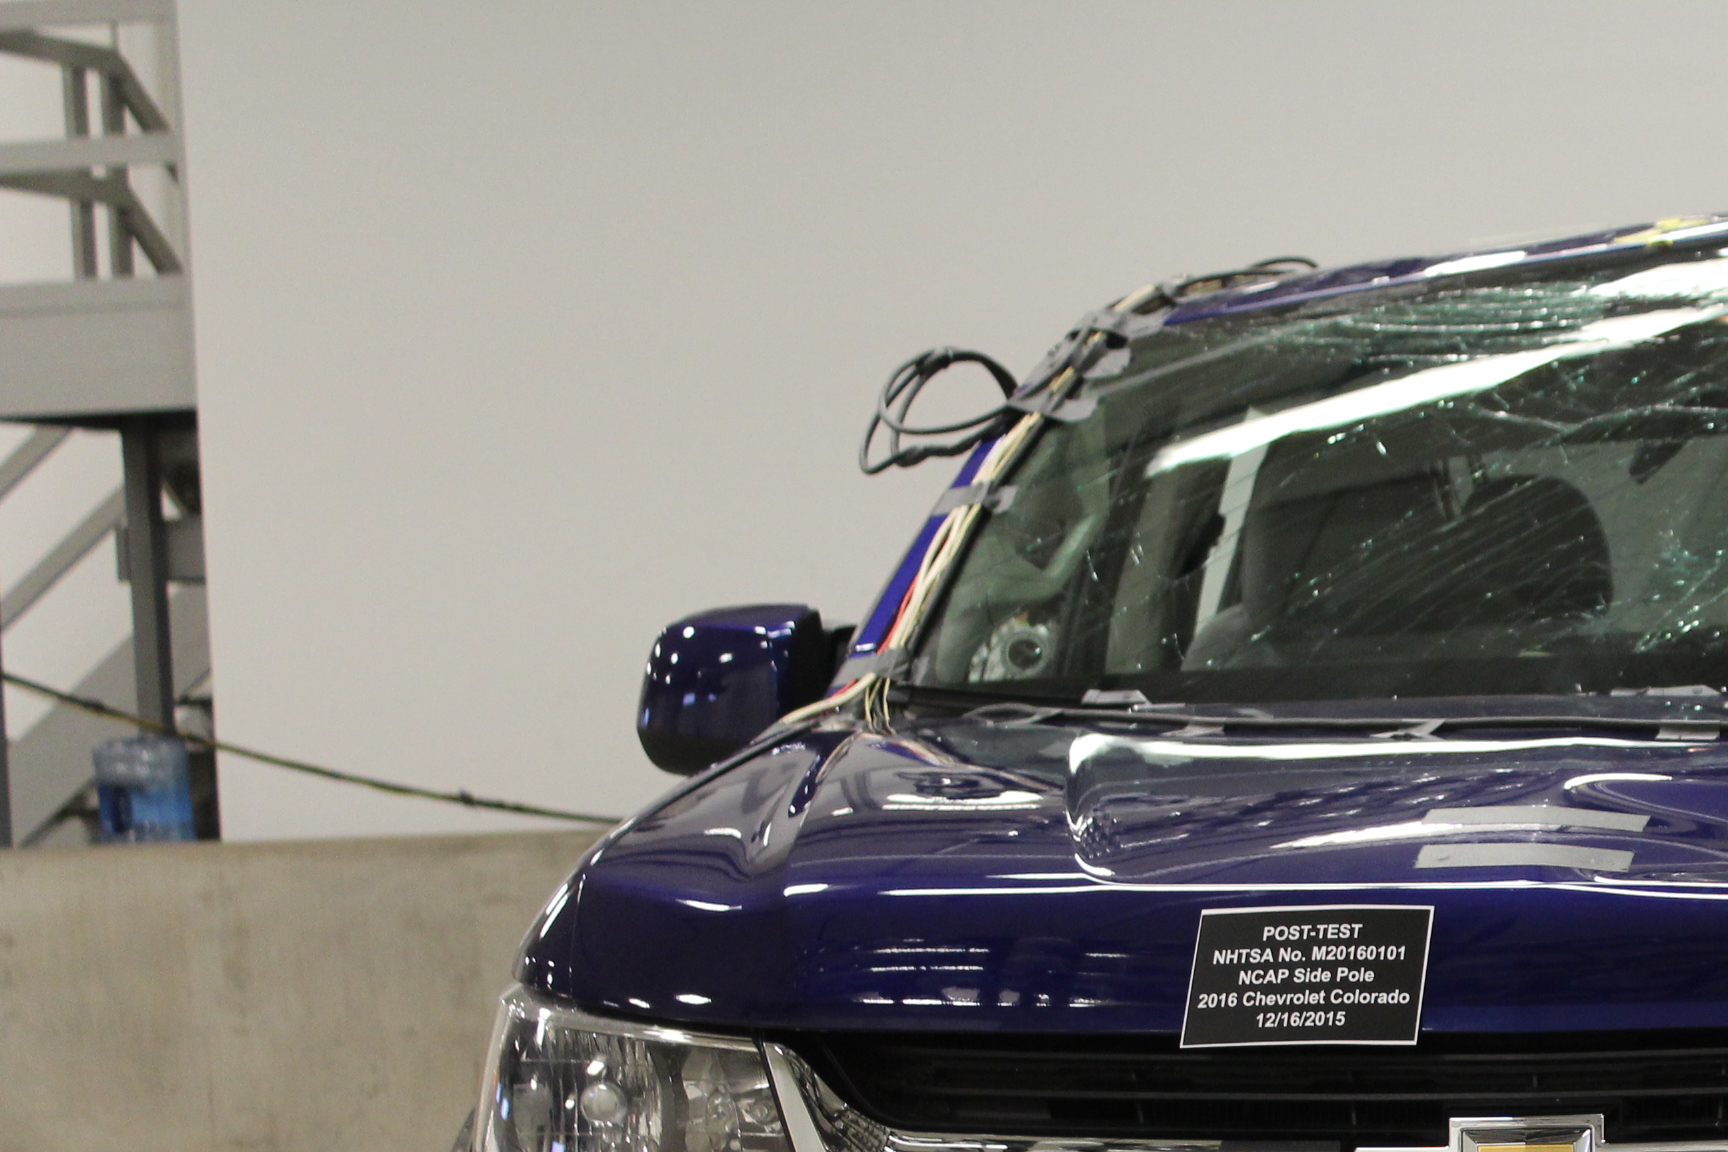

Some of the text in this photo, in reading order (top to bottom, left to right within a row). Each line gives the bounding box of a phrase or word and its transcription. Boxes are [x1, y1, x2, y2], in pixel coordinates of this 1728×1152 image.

[1263, 924, 1363, 941] POST-TEST
[1213, 946, 1405, 964] NHTSA No. M20160101
[1239, 967, 1374, 985] NCAP Side Pole
[1198, 989, 1409, 1008] 2016 Chevrolet Colorado
[1257, 1011, 1345, 1027] 12/16/2015
